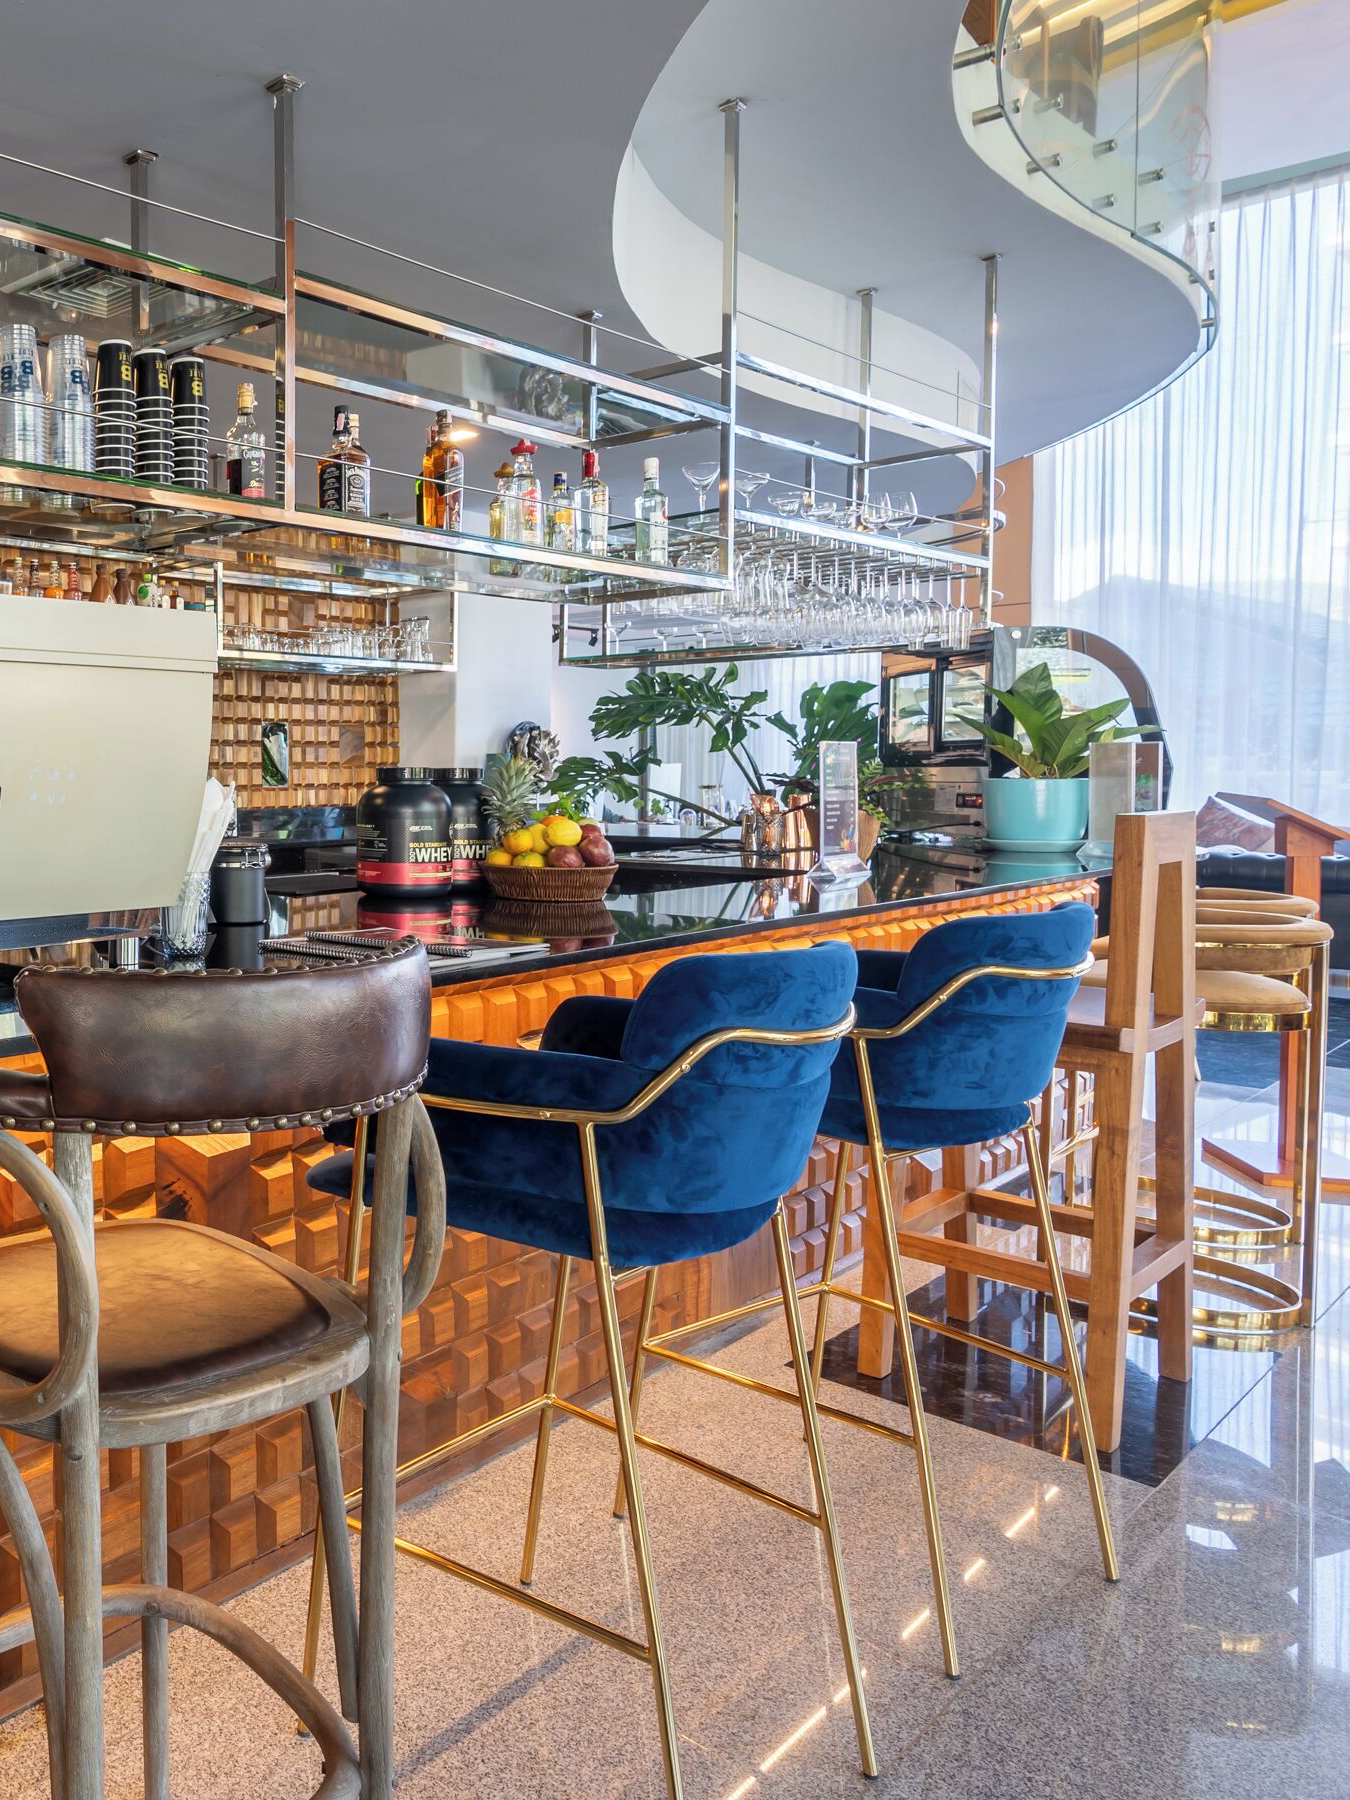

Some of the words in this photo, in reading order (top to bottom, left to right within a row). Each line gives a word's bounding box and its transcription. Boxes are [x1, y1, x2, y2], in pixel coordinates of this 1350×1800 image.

[0, 365, 13, 381] B
[20, 360, 34, 375] B
[120, 364, 131, 382] B
[70, 369, 83, 384] B
[158, 371, 169, 388] B
[191, 381, 203, 396] B
[415, 847, 452, 863] WHEY
